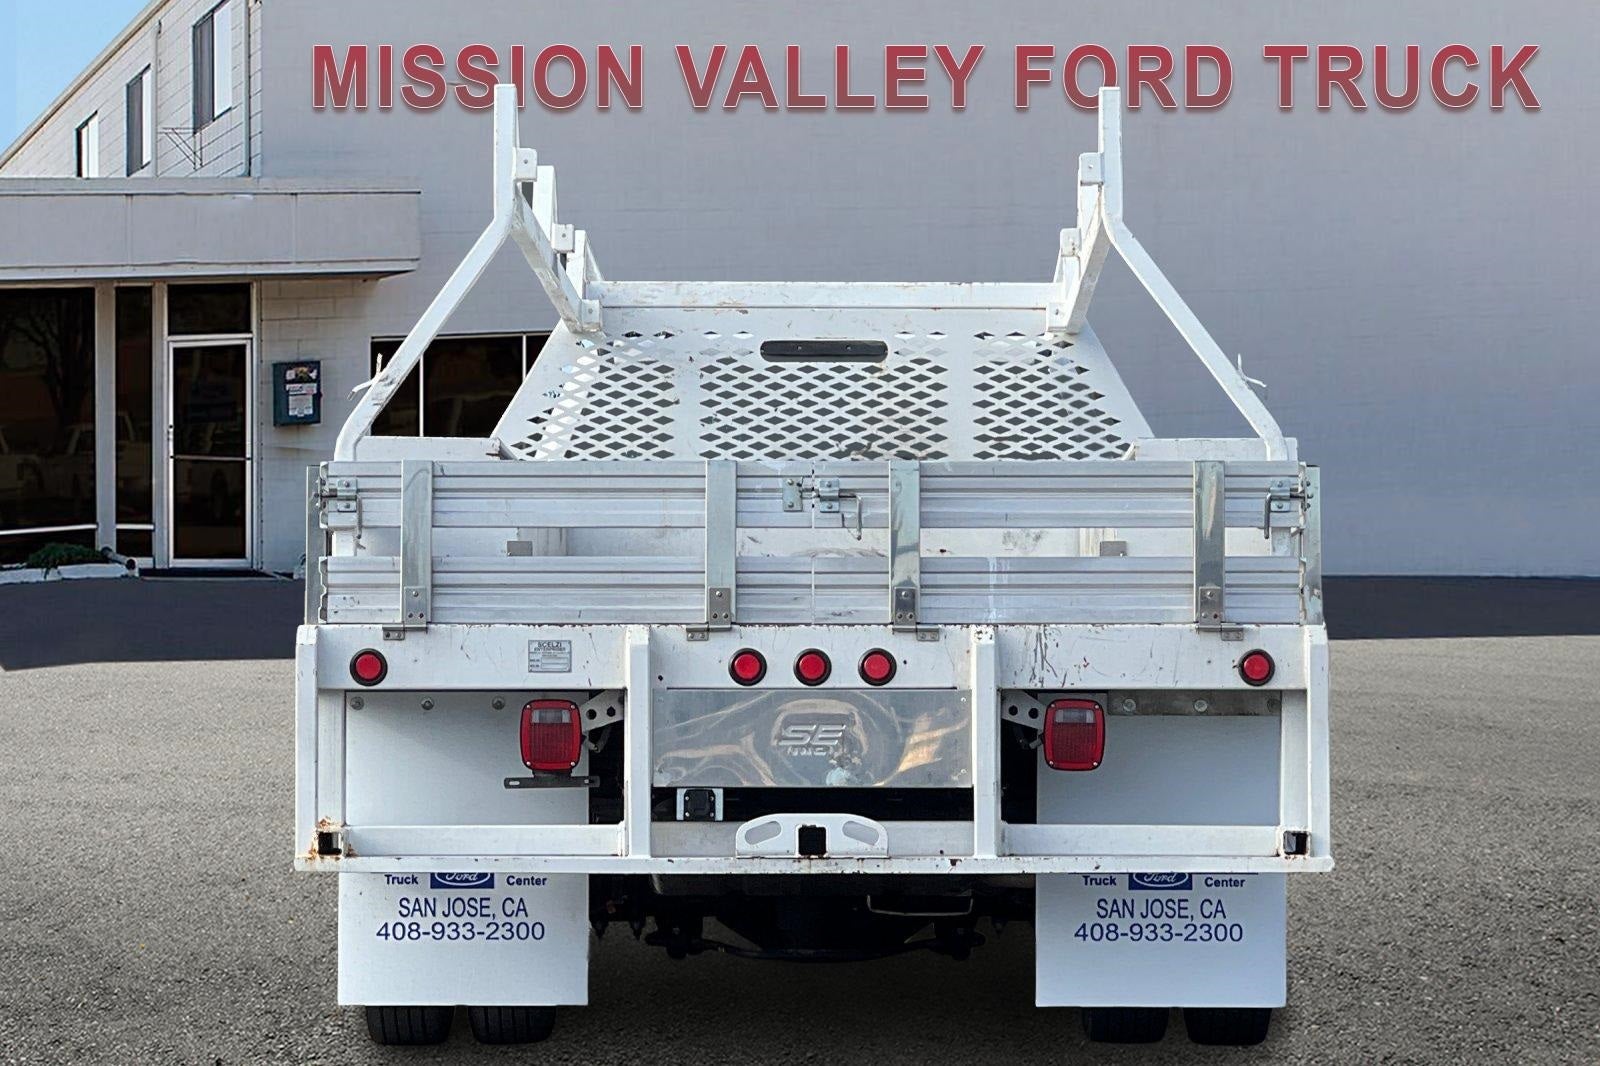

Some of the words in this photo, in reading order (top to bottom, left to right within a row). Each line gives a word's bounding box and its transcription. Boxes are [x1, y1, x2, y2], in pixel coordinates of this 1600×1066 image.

[312, 44, 643, 109] MISSION
[674, 44, 986, 108] VALLEY
[1014, 44, 1233, 109] FORD
[1263, 44, 1541, 109] TRUCK
[384, 874, 419, 885] Truck
[506, 875, 547, 886] Center
[1082, 875, 1117, 886] Truck
[1204, 877, 1246, 888] Center
[398, 897, 436, 918] SAN
[442, 897, 496, 920] JOSE,
[502, 897, 529, 918] CA
[1096, 898, 1135, 919] SAN
[1140, 898, 1194, 922] JOSE,
[1200, 898, 1227, 919] CA
[376, 921, 545, 941] 408-933-2300
[1074, 923, 1243, 942] 408-933-2300
